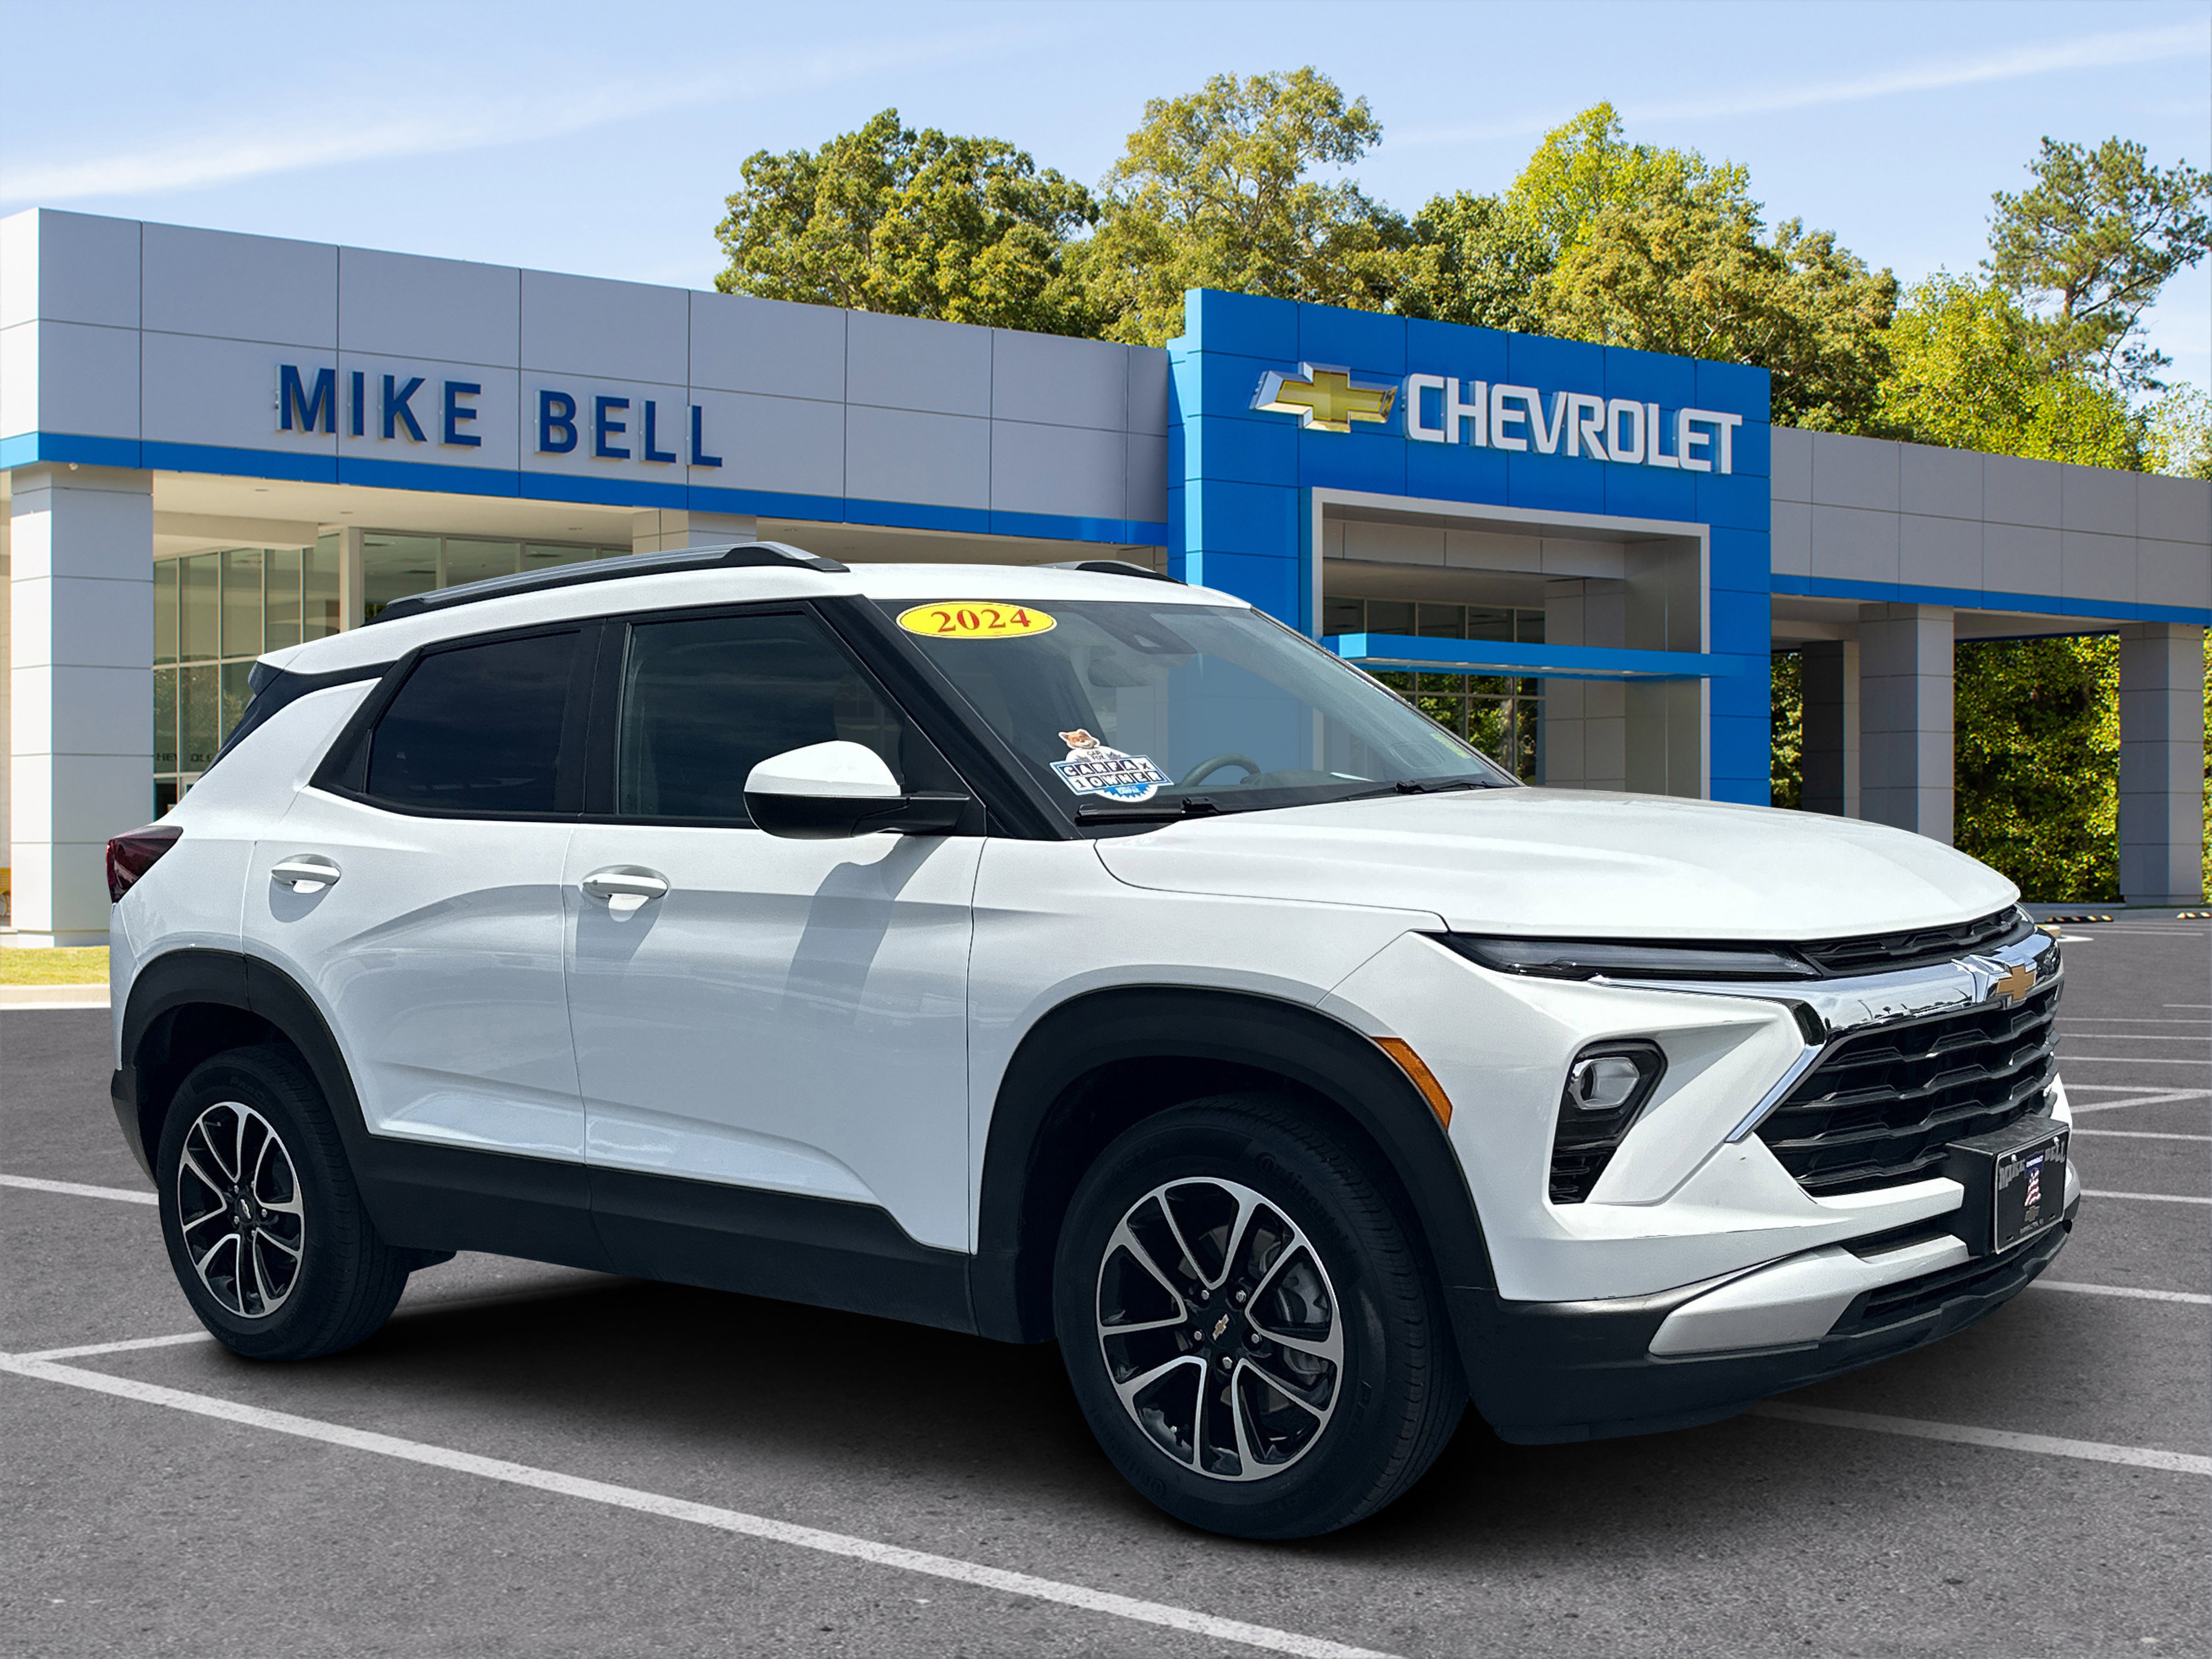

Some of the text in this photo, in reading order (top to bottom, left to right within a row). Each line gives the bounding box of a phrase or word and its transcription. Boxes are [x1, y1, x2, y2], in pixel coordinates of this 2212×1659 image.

[276, 364, 723, 468] MIKE BELL
[1402, 373, 1743, 475] CHEVROLET
[931, 608, 1031, 633] 2024
[1062, 759, 1151, 777] CARFAX
[1089, 770, 1163, 787] OWNER
